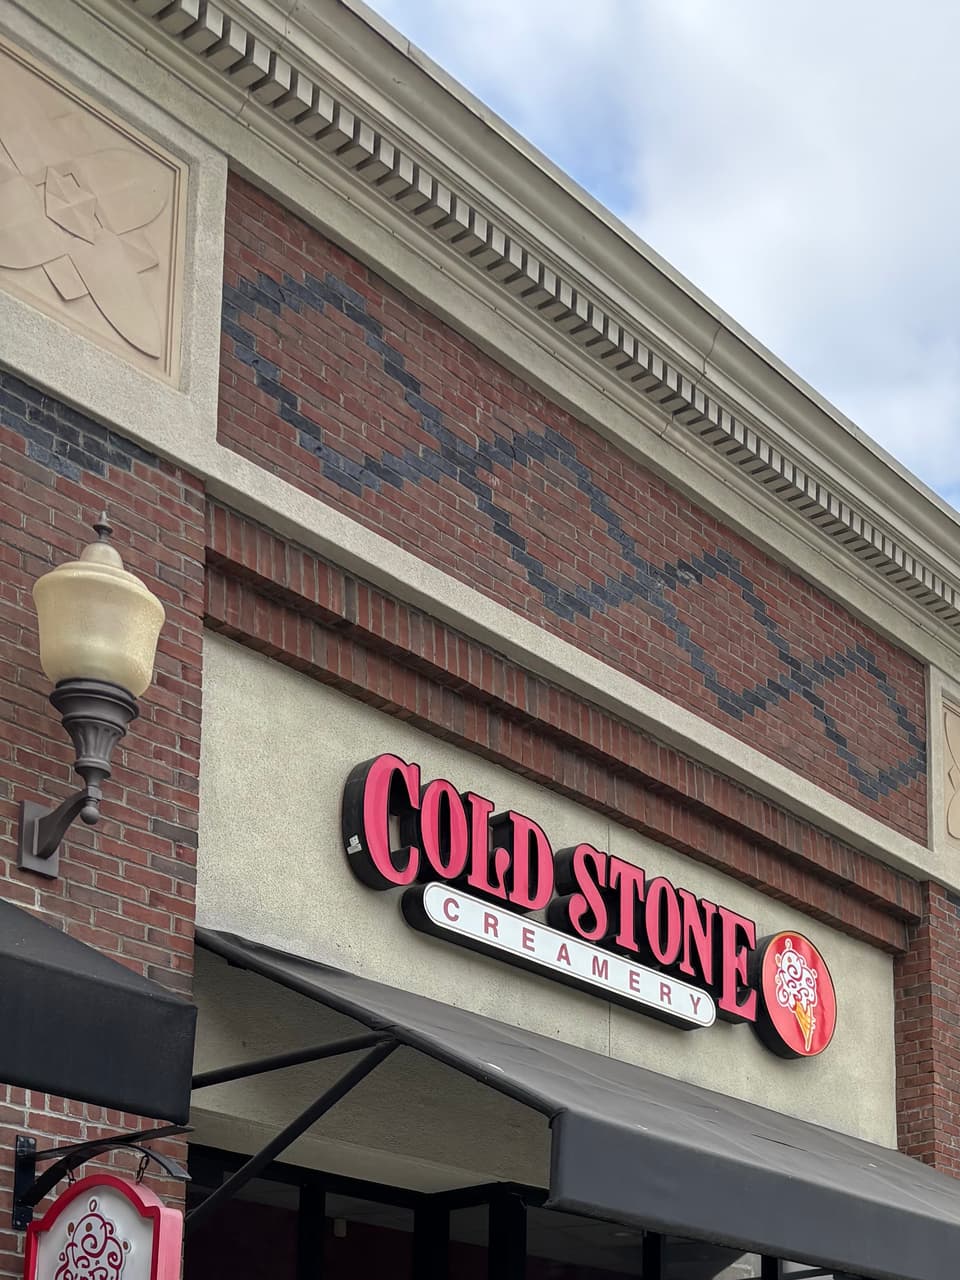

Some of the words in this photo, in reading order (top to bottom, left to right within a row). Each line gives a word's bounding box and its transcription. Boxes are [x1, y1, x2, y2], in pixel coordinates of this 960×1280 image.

[363, 753, 554, 910] COLD
[569, 843, 757, 1022] STONE
[444, 897, 705, 1015] CREAMERY
